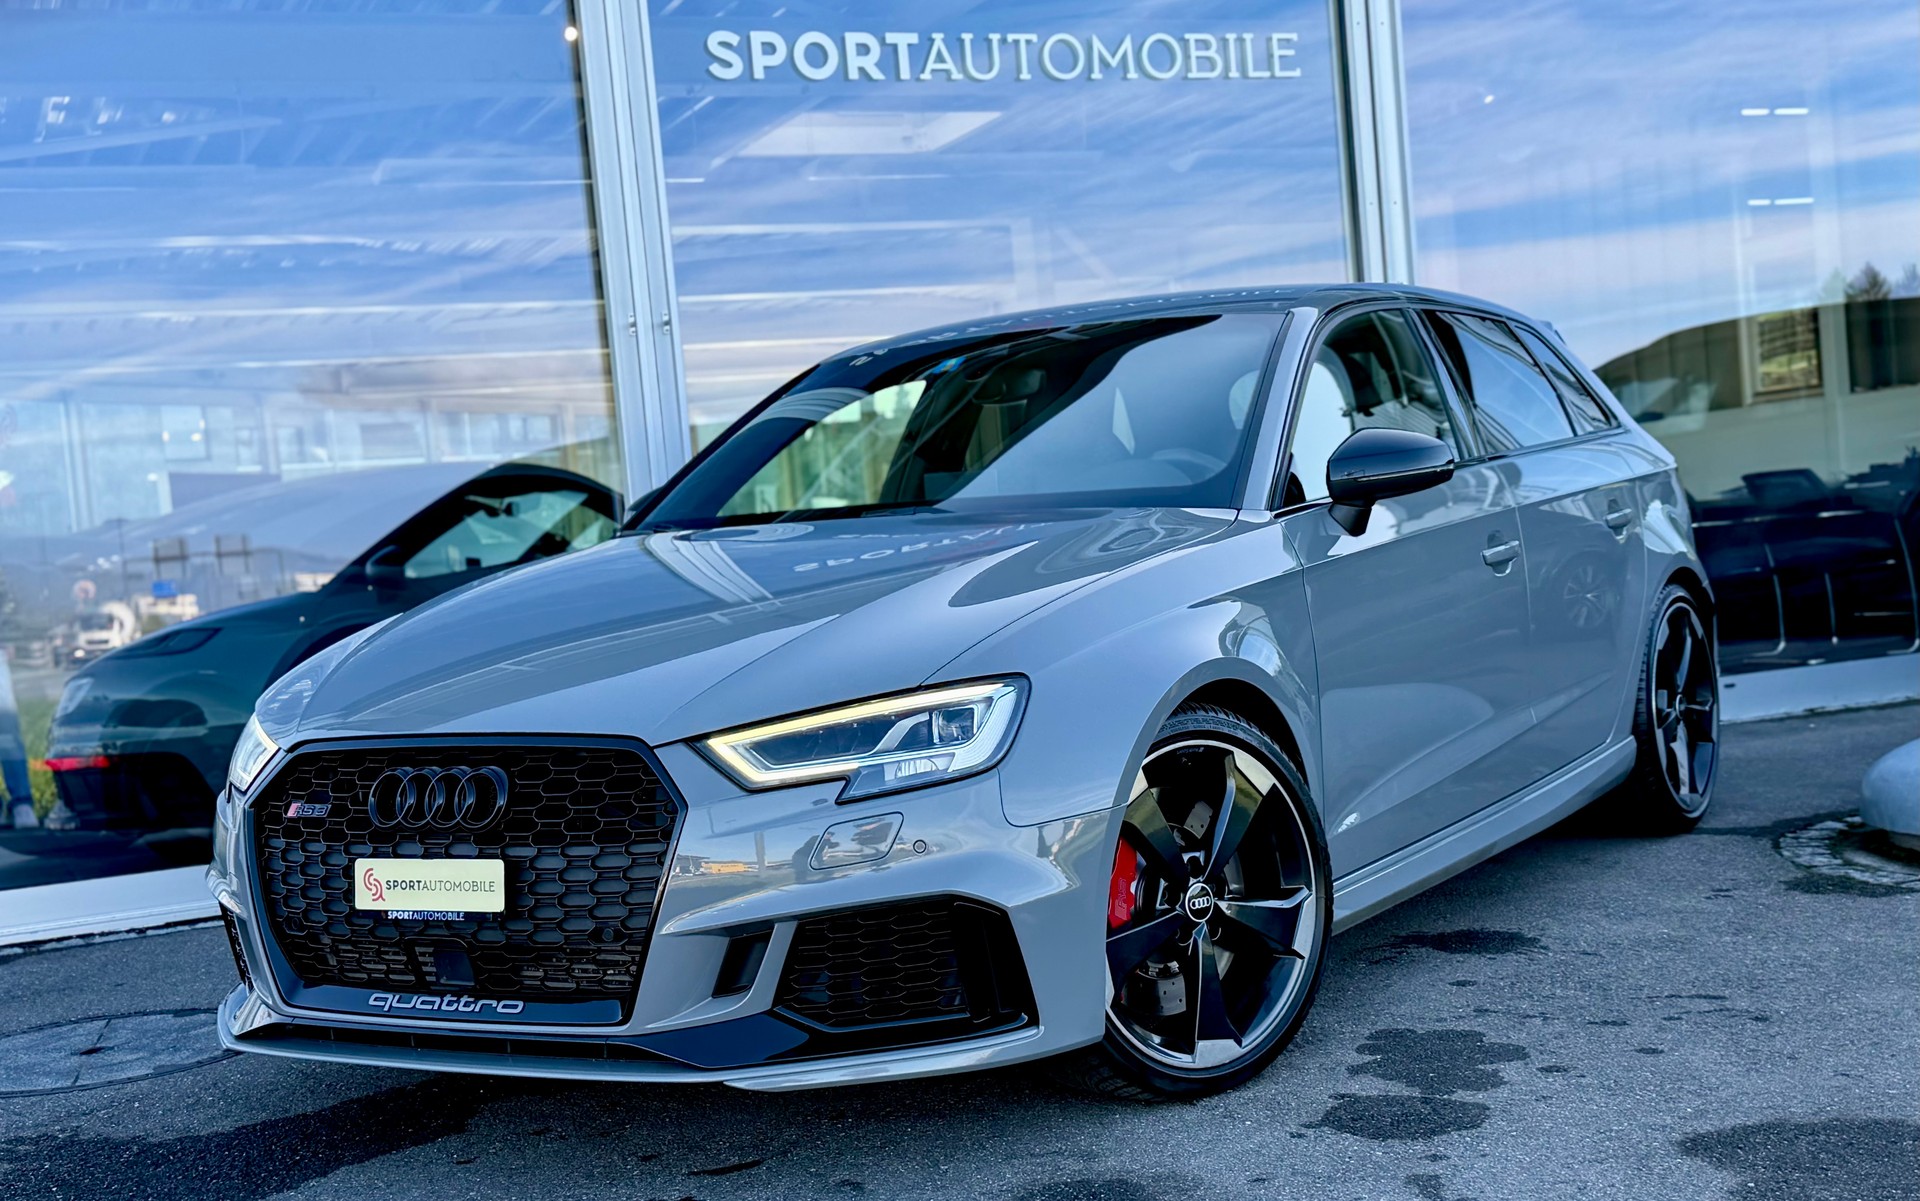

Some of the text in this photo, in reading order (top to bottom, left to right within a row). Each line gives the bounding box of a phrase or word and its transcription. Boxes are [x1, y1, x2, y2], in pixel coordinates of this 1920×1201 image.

[706, 30, 1301, 80] SPORTAUTOMOBILE
[386, 879, 495, 892] SPORTAUTOMOBILE
[388, 911, 465, 921] SPORTAUTOMOBILE
[368, 993, 524, 1014] quattro
